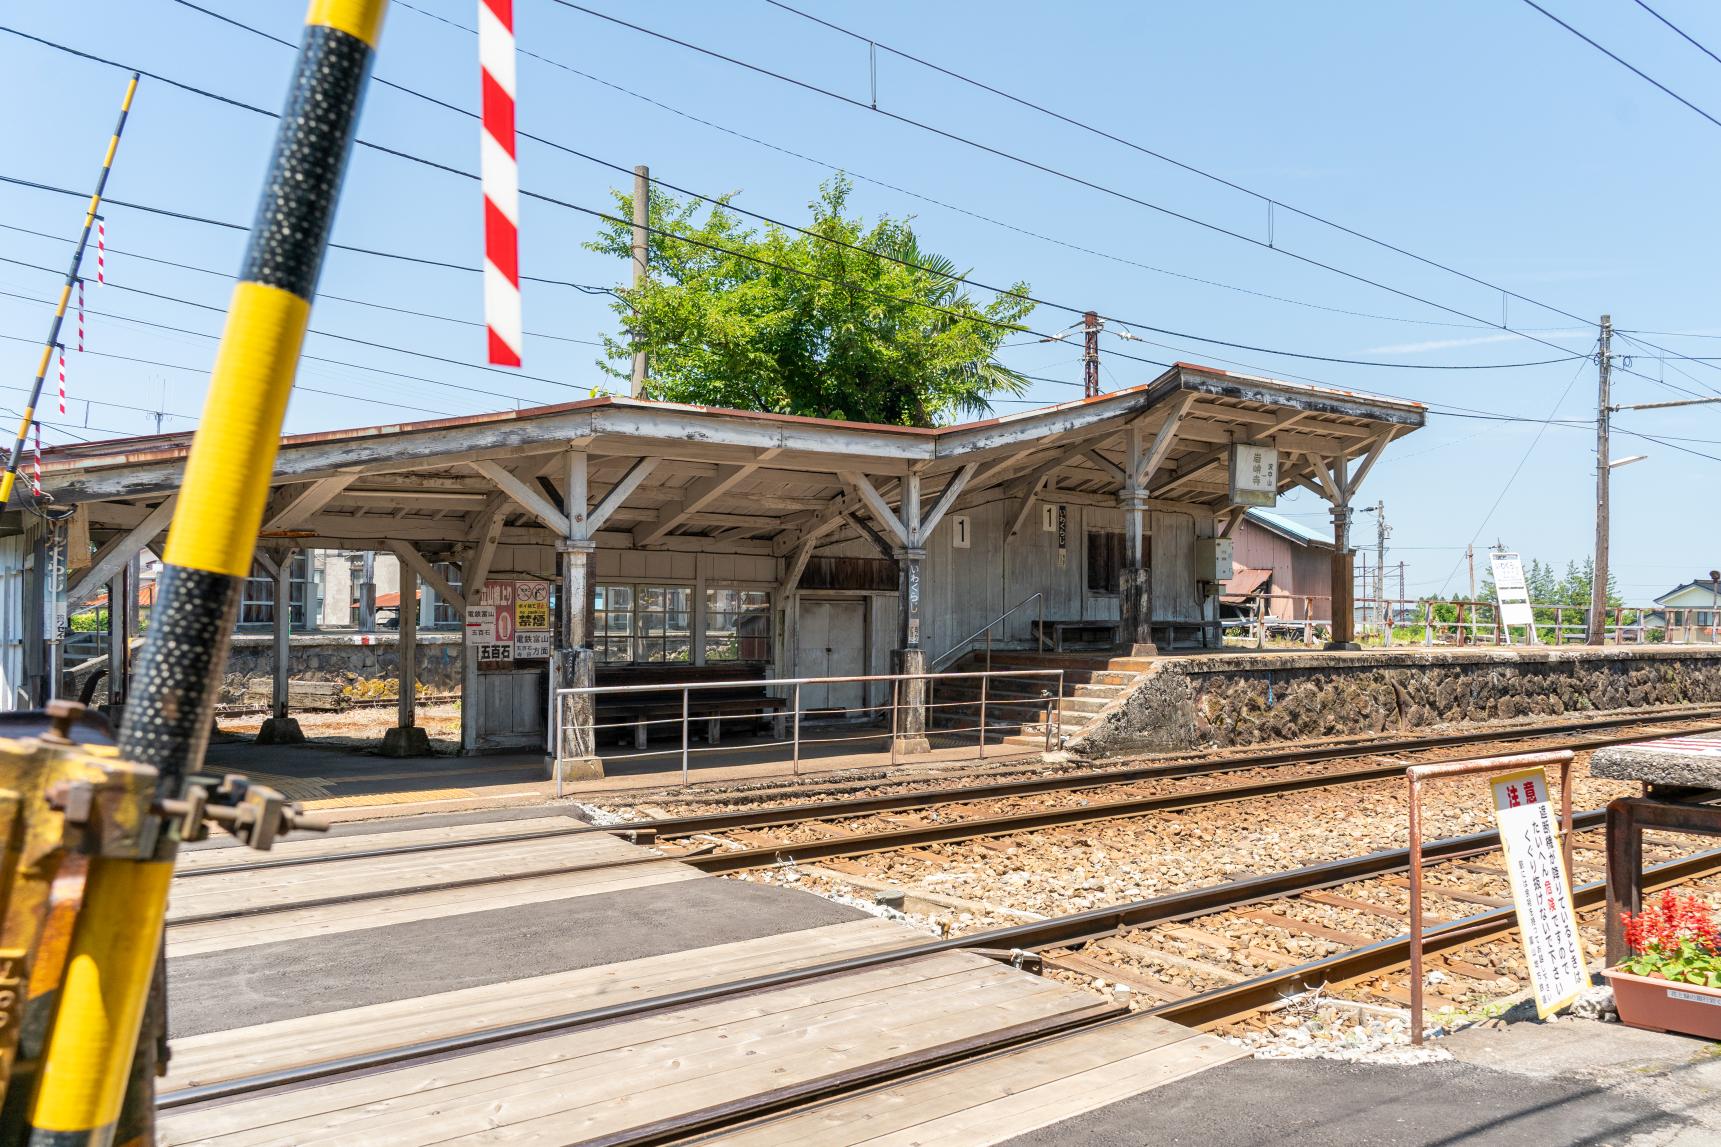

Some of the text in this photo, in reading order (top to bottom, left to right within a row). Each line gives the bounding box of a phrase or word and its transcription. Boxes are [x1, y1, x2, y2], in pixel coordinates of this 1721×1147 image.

[1046, 507, 1052, 528] 1
[958, 519, 965, 543] 1
[910, 564, 920, 613] いわくらじ
[518, 614, 546, 627] 禁煙
[481, 644, 511, 659] 五百石
[1506, 781, 1537, 808] 注意
